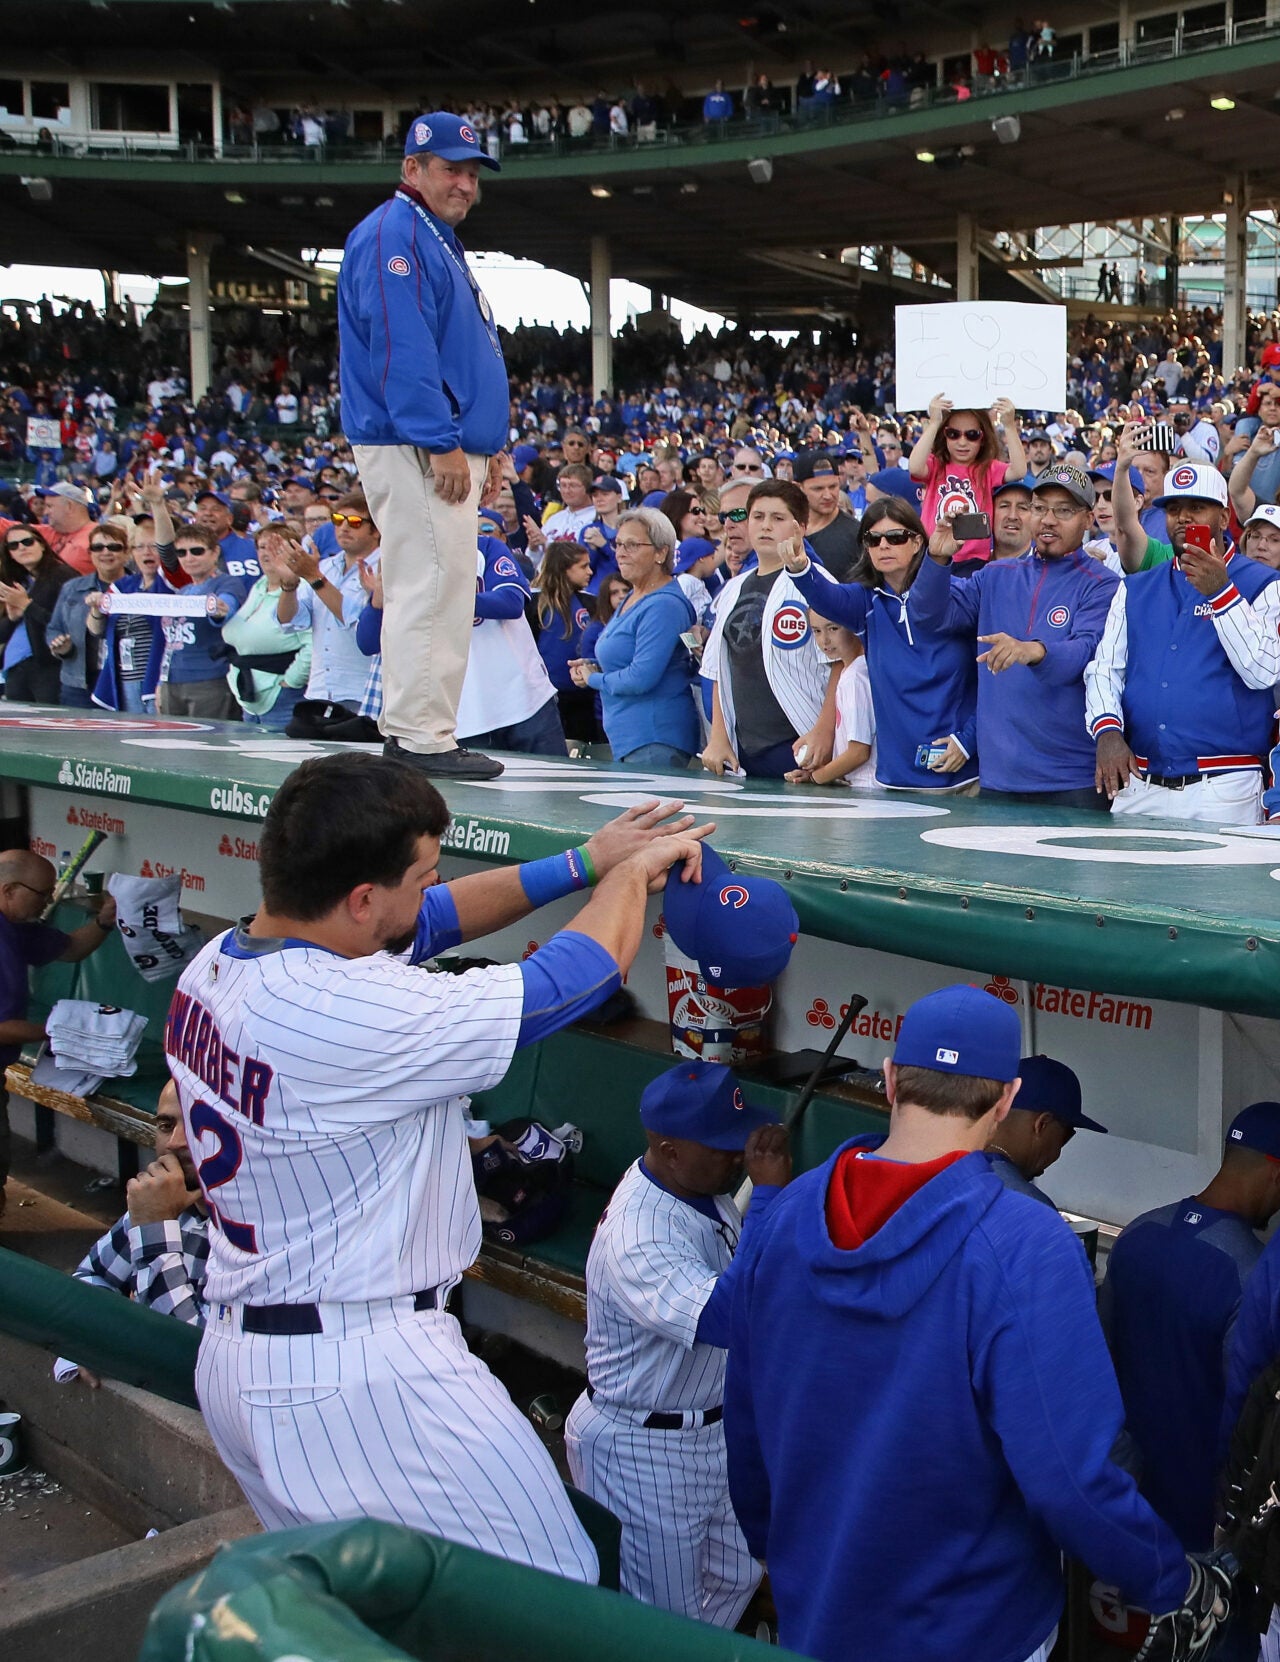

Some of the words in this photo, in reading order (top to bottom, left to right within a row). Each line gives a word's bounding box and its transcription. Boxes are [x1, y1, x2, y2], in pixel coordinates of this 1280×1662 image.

[909, 311, 940, 343] I
[916, 350, 1048, 391] CUBS
[773, 608, 808, 642] CUBS
[210, 783, 272, 818] cubs.c
[719, 884, 750, 909] C
